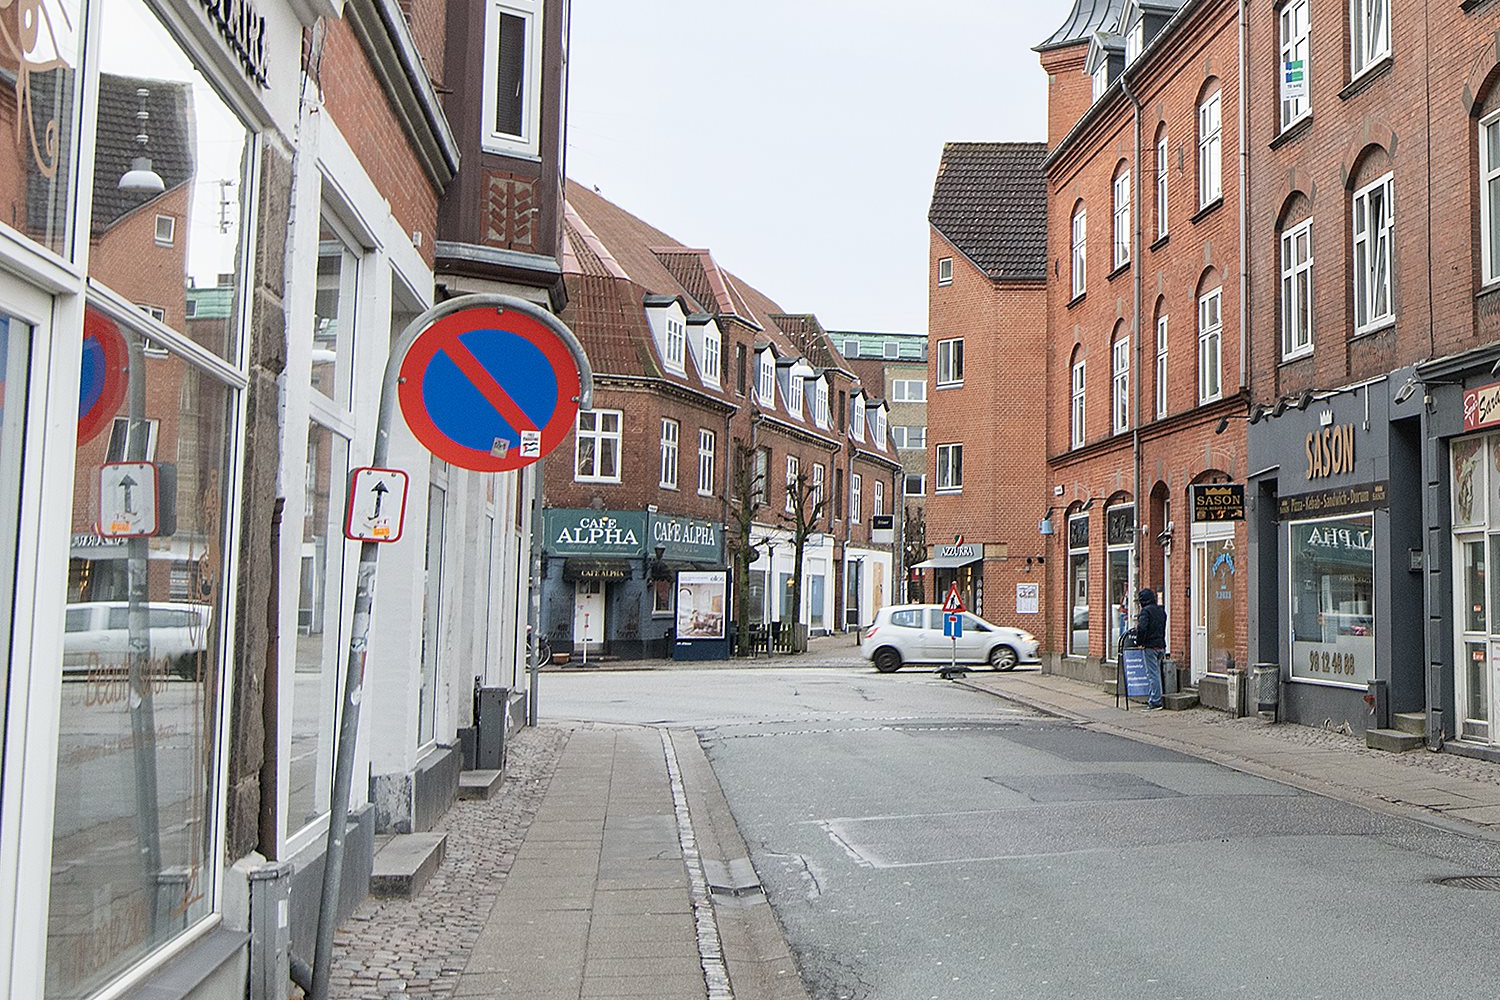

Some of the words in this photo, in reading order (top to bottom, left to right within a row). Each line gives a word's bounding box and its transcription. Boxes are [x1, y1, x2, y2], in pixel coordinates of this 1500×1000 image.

[1305, 423, 1354, 480] SASON
[1197, 495, 1240, 506] SASON
[580, 518, 617, 529] CAFE
[556, 528, 638, 545] ALPHA
[654, 521, 682, 542] CAFE
[682, 525, 715, 546] ALPHA
[940, 546, 974, 557] AZZURRA
[1310, 650, 1319, 672] 98
[1321, 651, 1330, 673] 12
